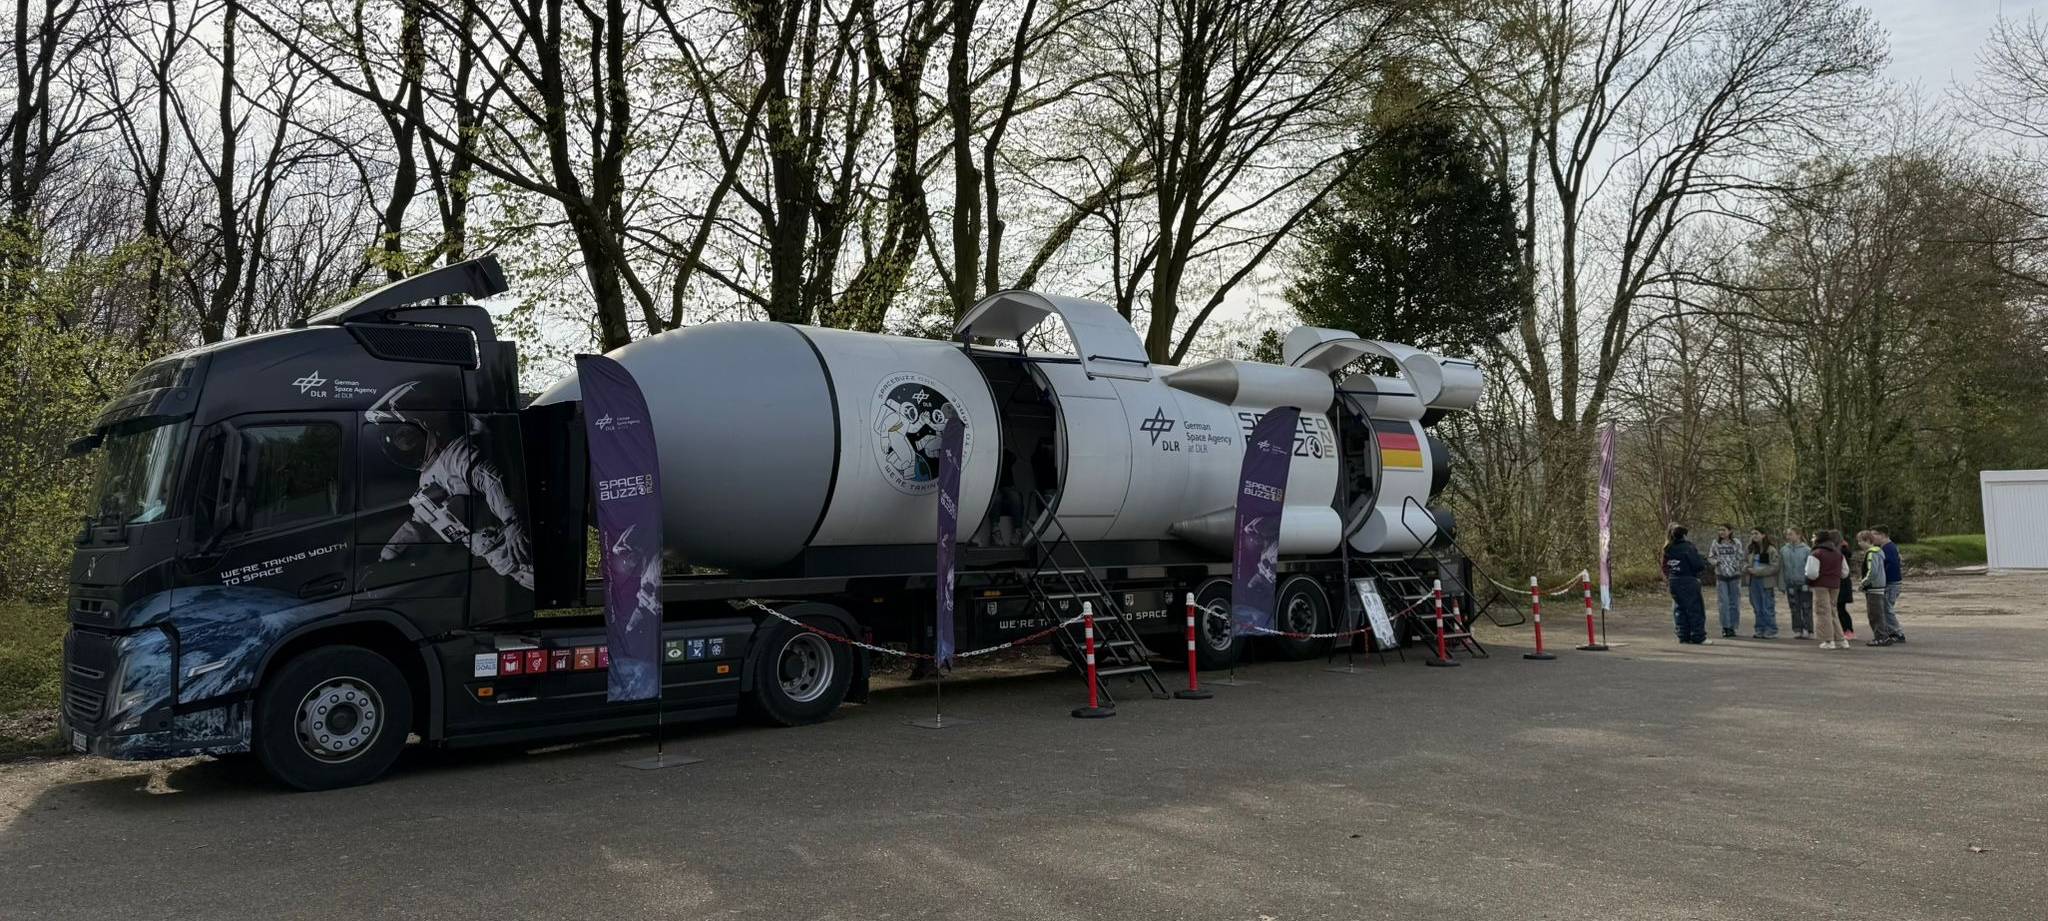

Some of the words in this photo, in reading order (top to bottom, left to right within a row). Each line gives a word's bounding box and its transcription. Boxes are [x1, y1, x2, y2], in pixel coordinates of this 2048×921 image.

[311, 390, 327, 398] DLR
[1184, 421, 1211, 430] German
[1186, 432, 1206, 443] Space
[1208, 434, 1232, 445] Agency
[1162, 440, 1180, 452] DLR
[1195, 444, 1208, 453] DLR
[600, 475, 645, 491] SPACE
[600, 487, 638, 501] BUZZ
[220, 564, 260, 579] WE'RE
[262, 552, 306, 568] TAKING
[308, 542, 348, 558] YOUTH
[223, 577, 240, 587] TO
[242, 566, 284, 583] SPACE
[1136, 610, 1167, 620] SPACE
[1000, 619, 1035, 629] WE'RE
